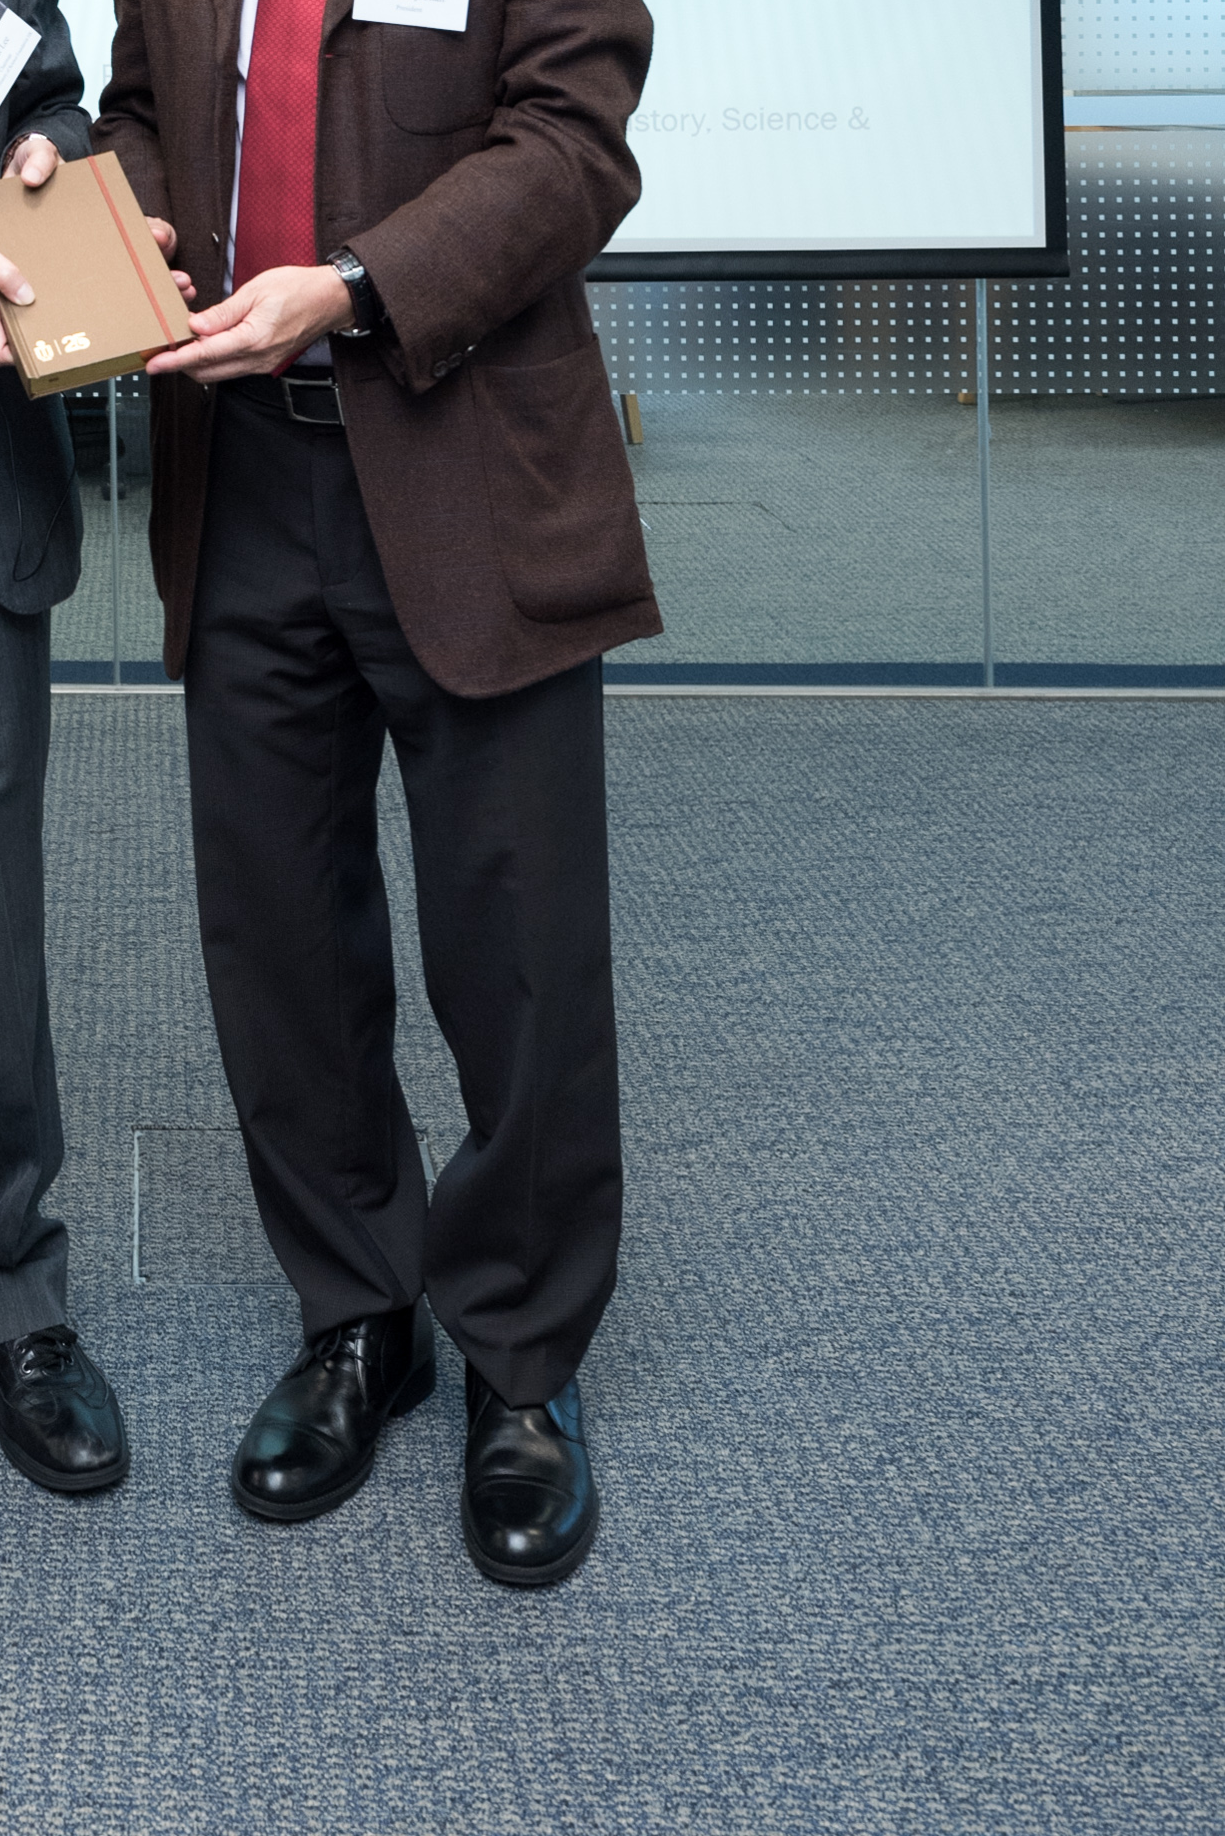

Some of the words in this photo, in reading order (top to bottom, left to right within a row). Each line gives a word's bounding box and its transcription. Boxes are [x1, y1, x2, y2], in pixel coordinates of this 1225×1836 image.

[627, 109, 712, 138] istory,
[721, 107, 838, 131] Science
[847, 105, 871, 131] &
[60, 331, 91, 353] 25
